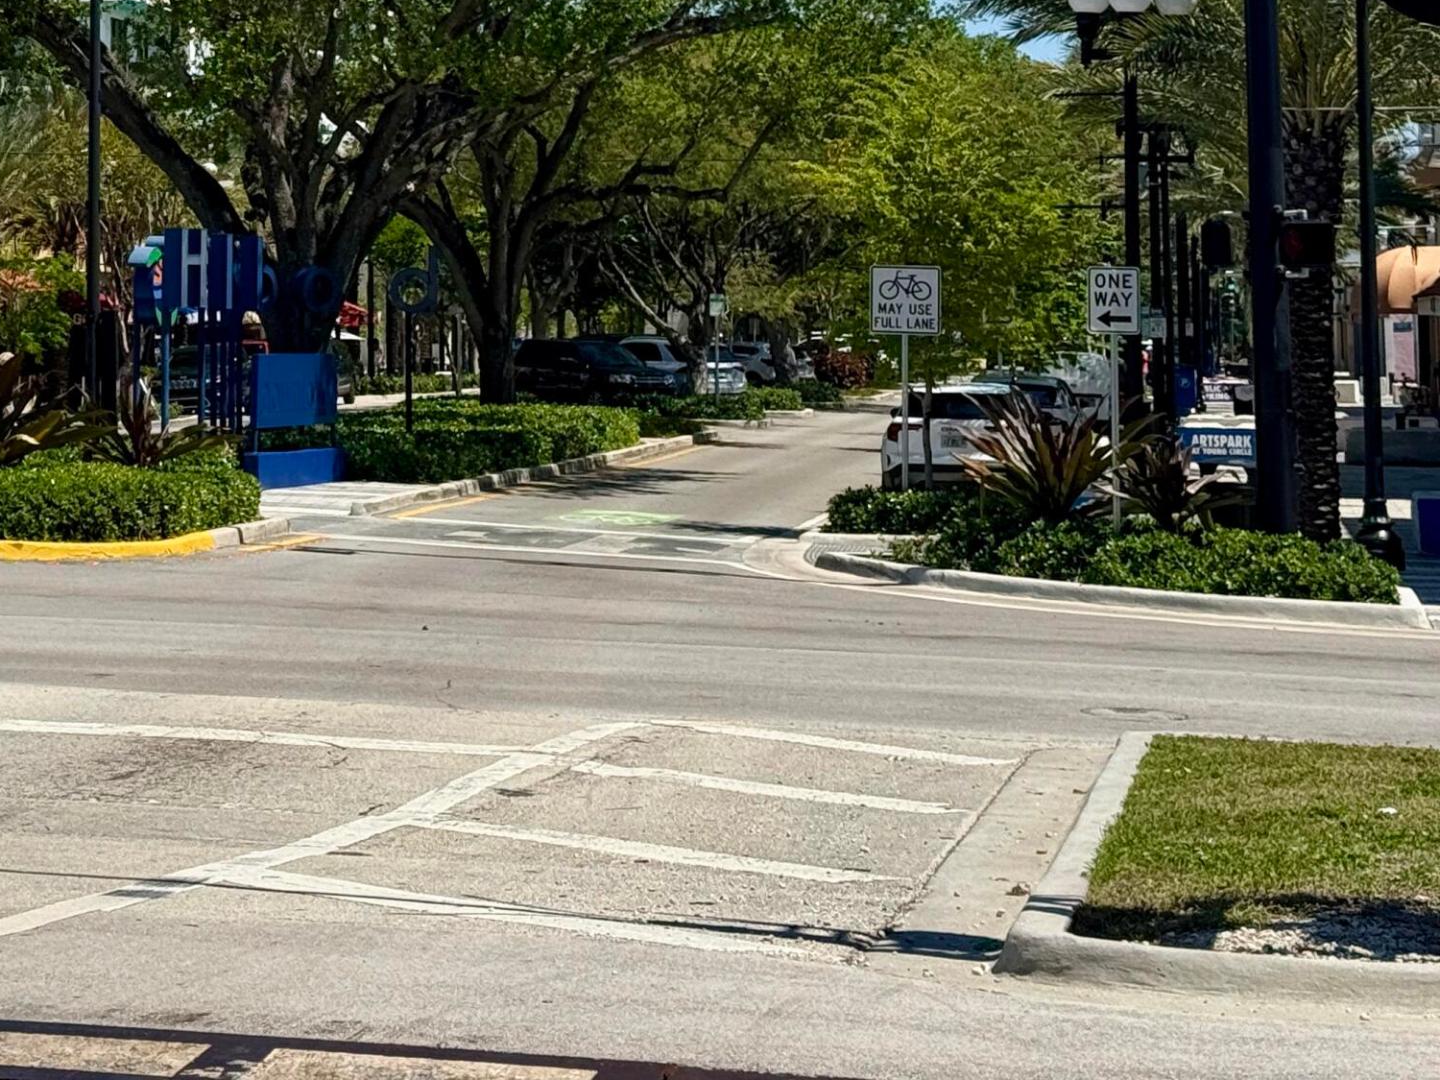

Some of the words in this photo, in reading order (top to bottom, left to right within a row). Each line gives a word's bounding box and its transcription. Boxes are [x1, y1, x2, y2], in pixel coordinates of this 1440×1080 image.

[1095, 273, 1133, 289] ONE
[1094, 291, 1133, 308] WAY
[878, 302, 903, 314] MAY
[909, 303, 932, 315] USE
[874, 316, 901, 329] FULL
[906, 317, 935, 330] LANE
[1191, 434, 1252, 448] ARTSPARK
[1229, 448, 1252, 456] CIRCLE
